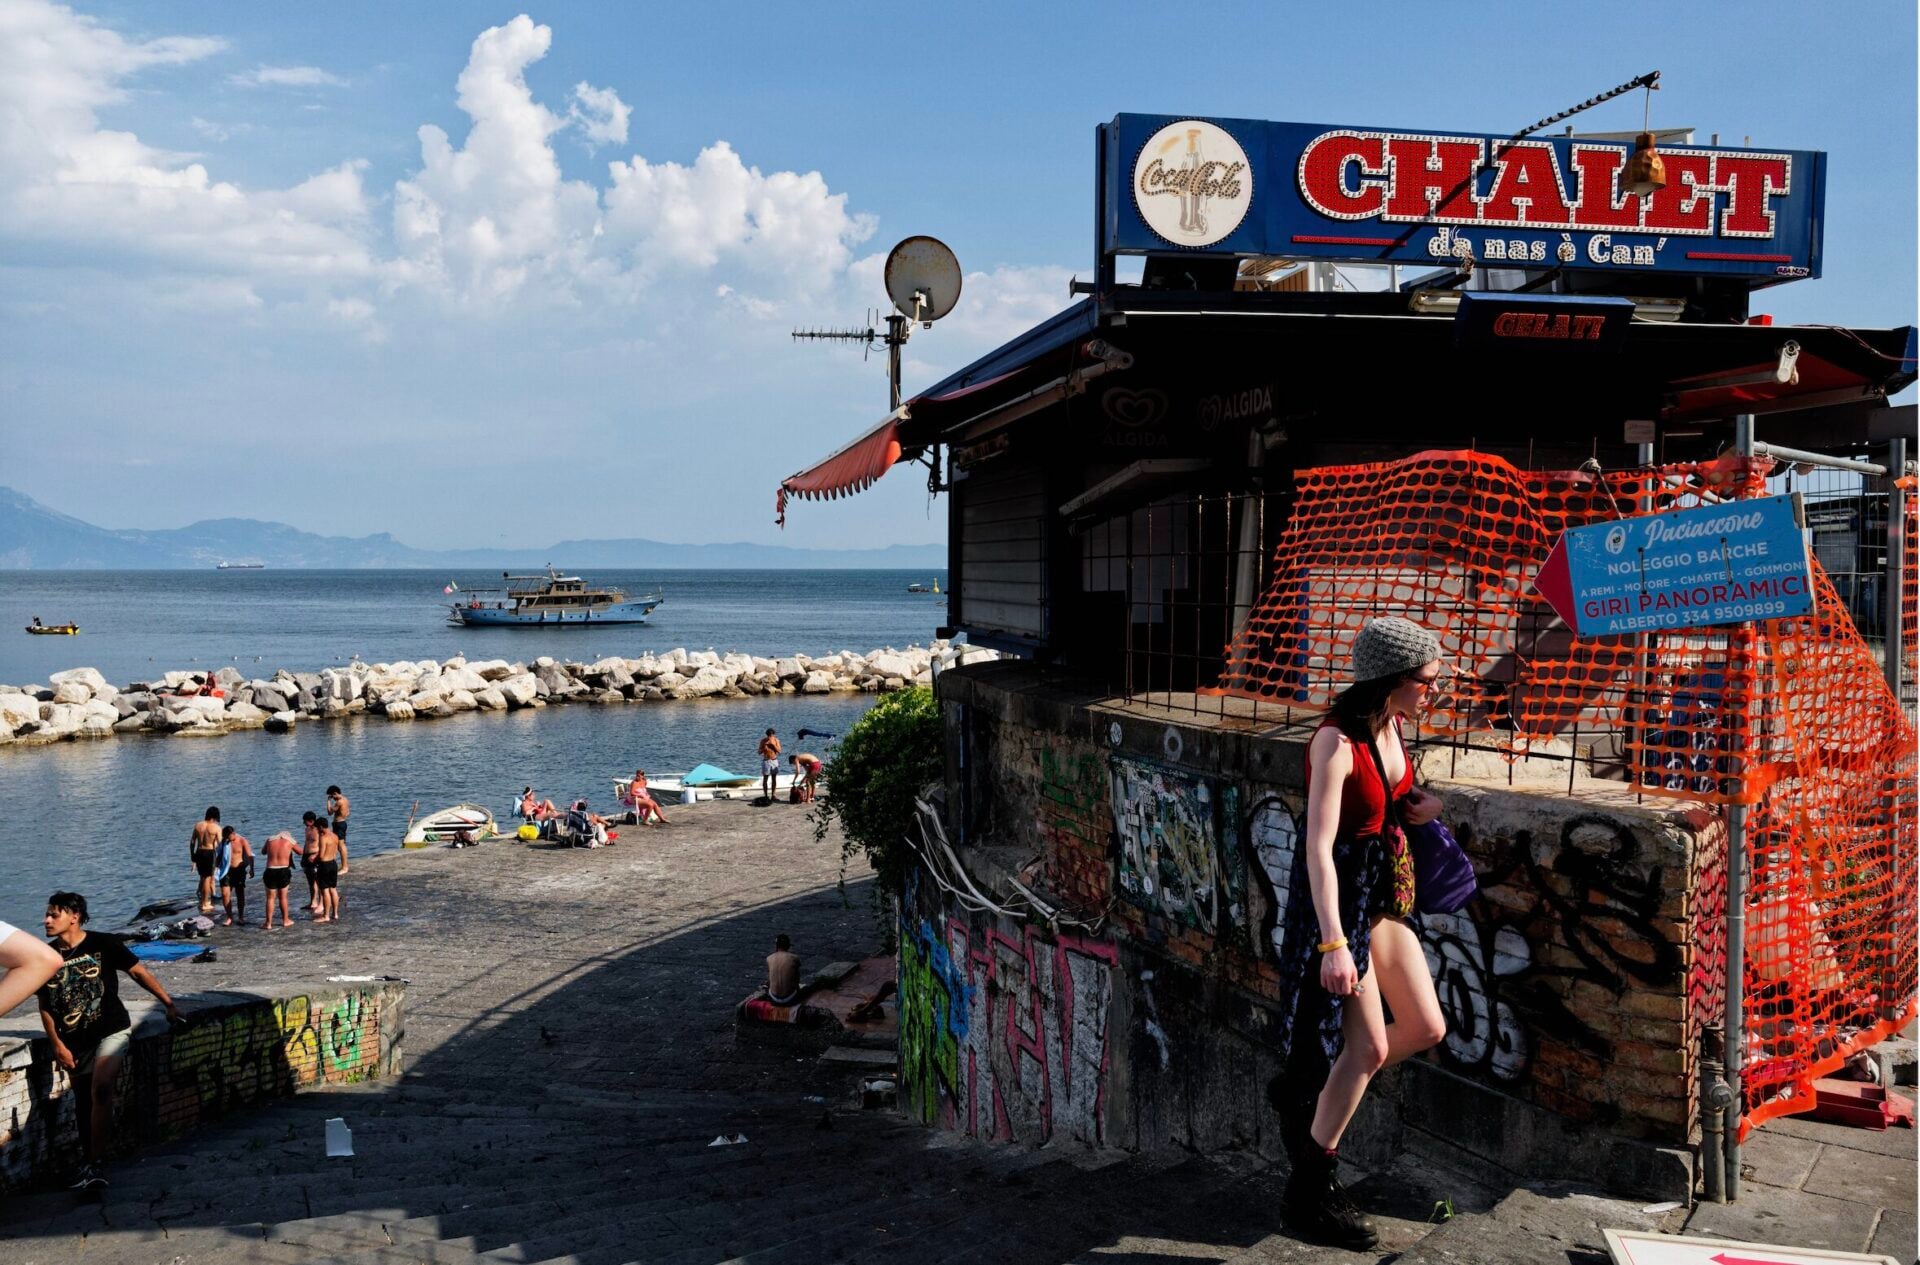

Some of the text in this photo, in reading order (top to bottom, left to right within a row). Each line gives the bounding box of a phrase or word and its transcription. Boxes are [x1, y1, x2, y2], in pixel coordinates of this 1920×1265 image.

[1298, 129, 1792, 239] CHALET
[1428, 227, 1473, 258] da
[1484, 237, 1547, 261] nas
[1493, 312, 1606, 340] GELATI
[1224, 387, 1273, 421] ALGIDA
[1102, 431, 1169, 448] ALGIDA
[1645, 511, 1765, 549] Paciaccone
[1608, 542, 1769, 576] NOLEGGIO BARCHE
[1581, 589, 1588, 598] A
[1590, 585, 1615, 597] REMI
[1624, 579, 1671, 592] MOTORE
[1680, 570, 1734, 585] CHARTER
[1584, 575, 1809, 618] GIRI PANORAMICI
[1609, 601, 1786, 631] ALBERTO 334 9509899
